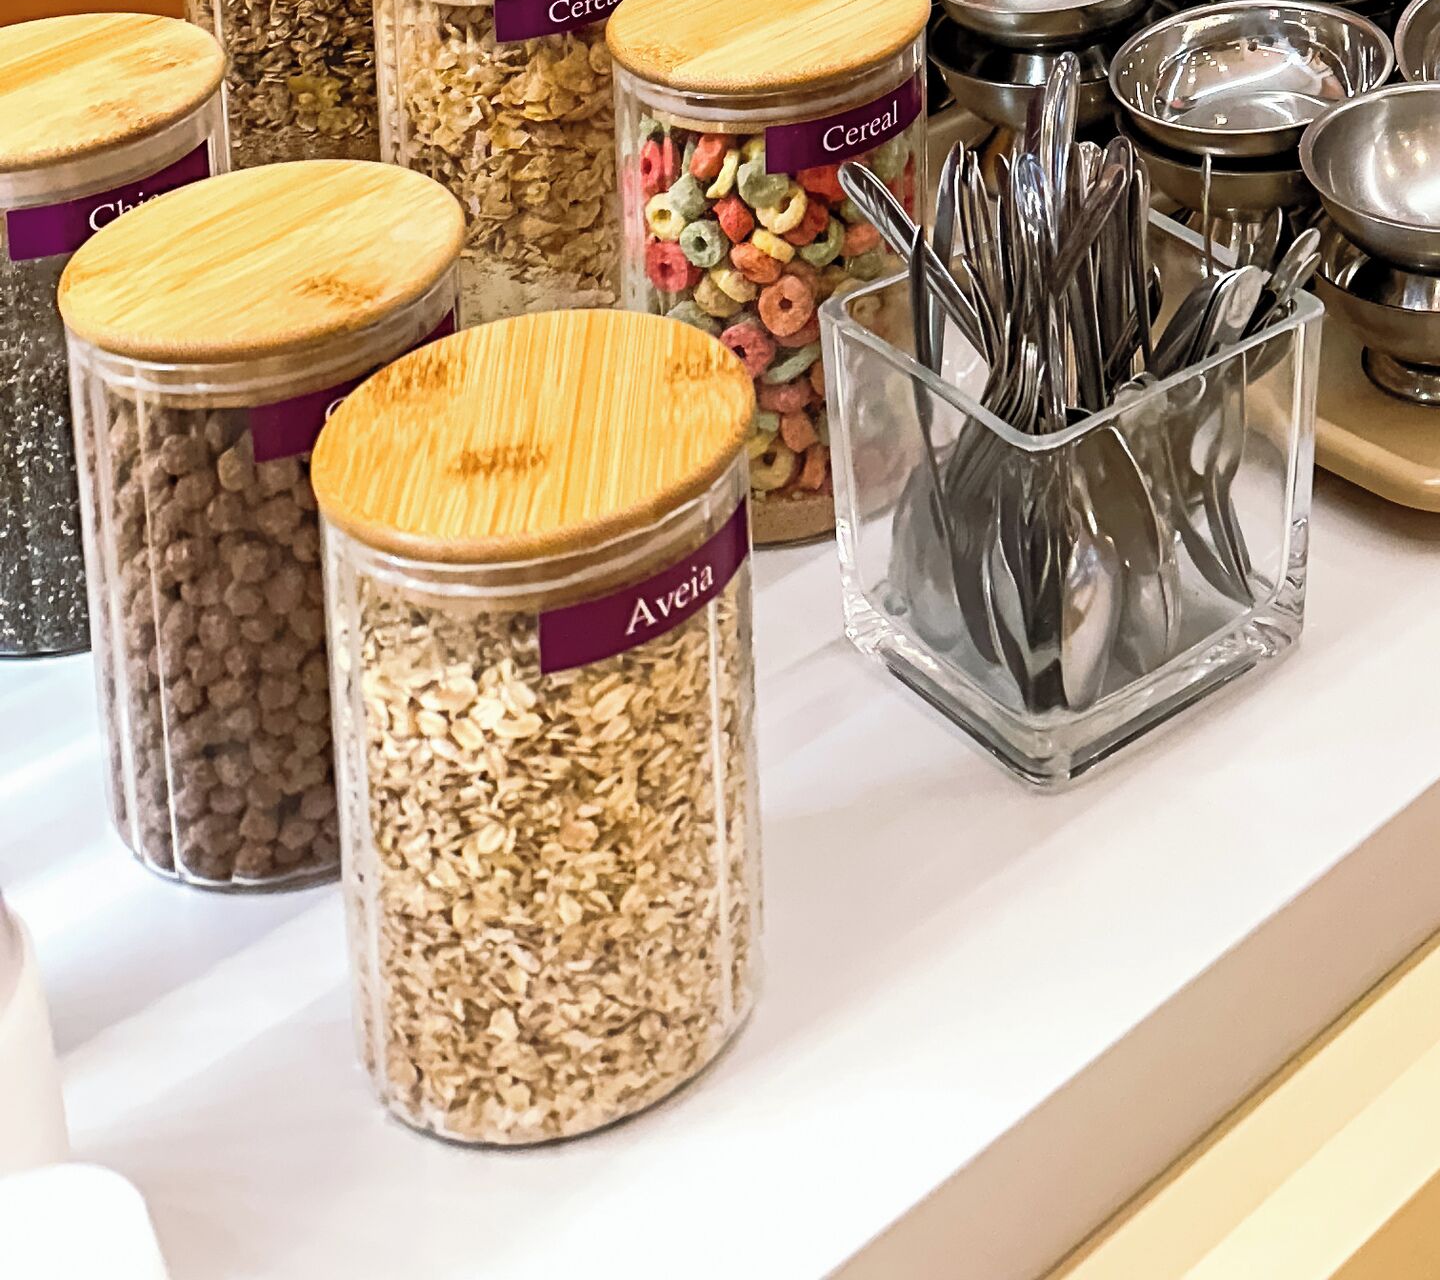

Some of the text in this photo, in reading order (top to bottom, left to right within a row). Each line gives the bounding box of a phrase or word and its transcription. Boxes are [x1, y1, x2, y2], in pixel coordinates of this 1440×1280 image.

[822, 99, 898, 152] Cereal
[88, 191, 159, 232] Ch
[625, 564, 714, 636] Aveia
